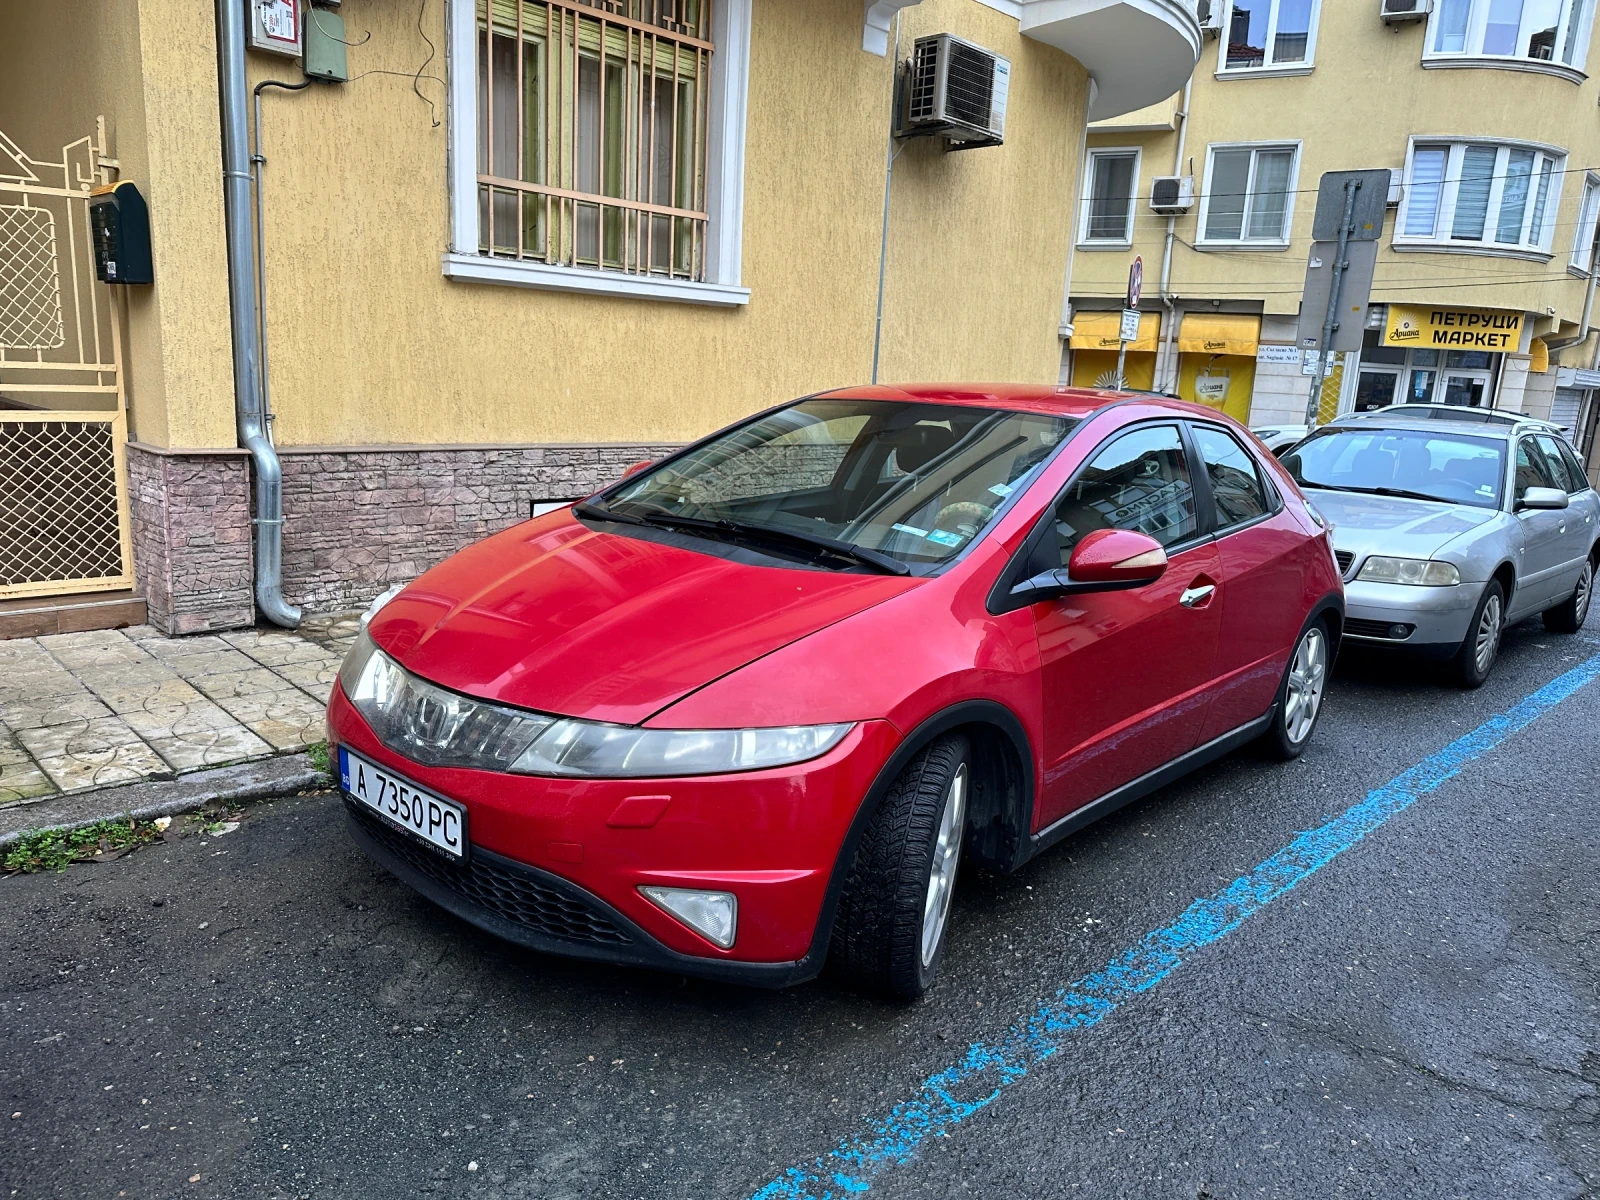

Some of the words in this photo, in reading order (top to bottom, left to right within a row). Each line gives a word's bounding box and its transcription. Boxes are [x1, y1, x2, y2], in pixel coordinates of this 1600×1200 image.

[1429, 311, 1520, 330] ПЕТРУЦИ
[1389, 328, 1420, 341] Ариана
[1432, 330, 1511, 347] МАРКЕТ
[376, 773, 424, 829] 7350
